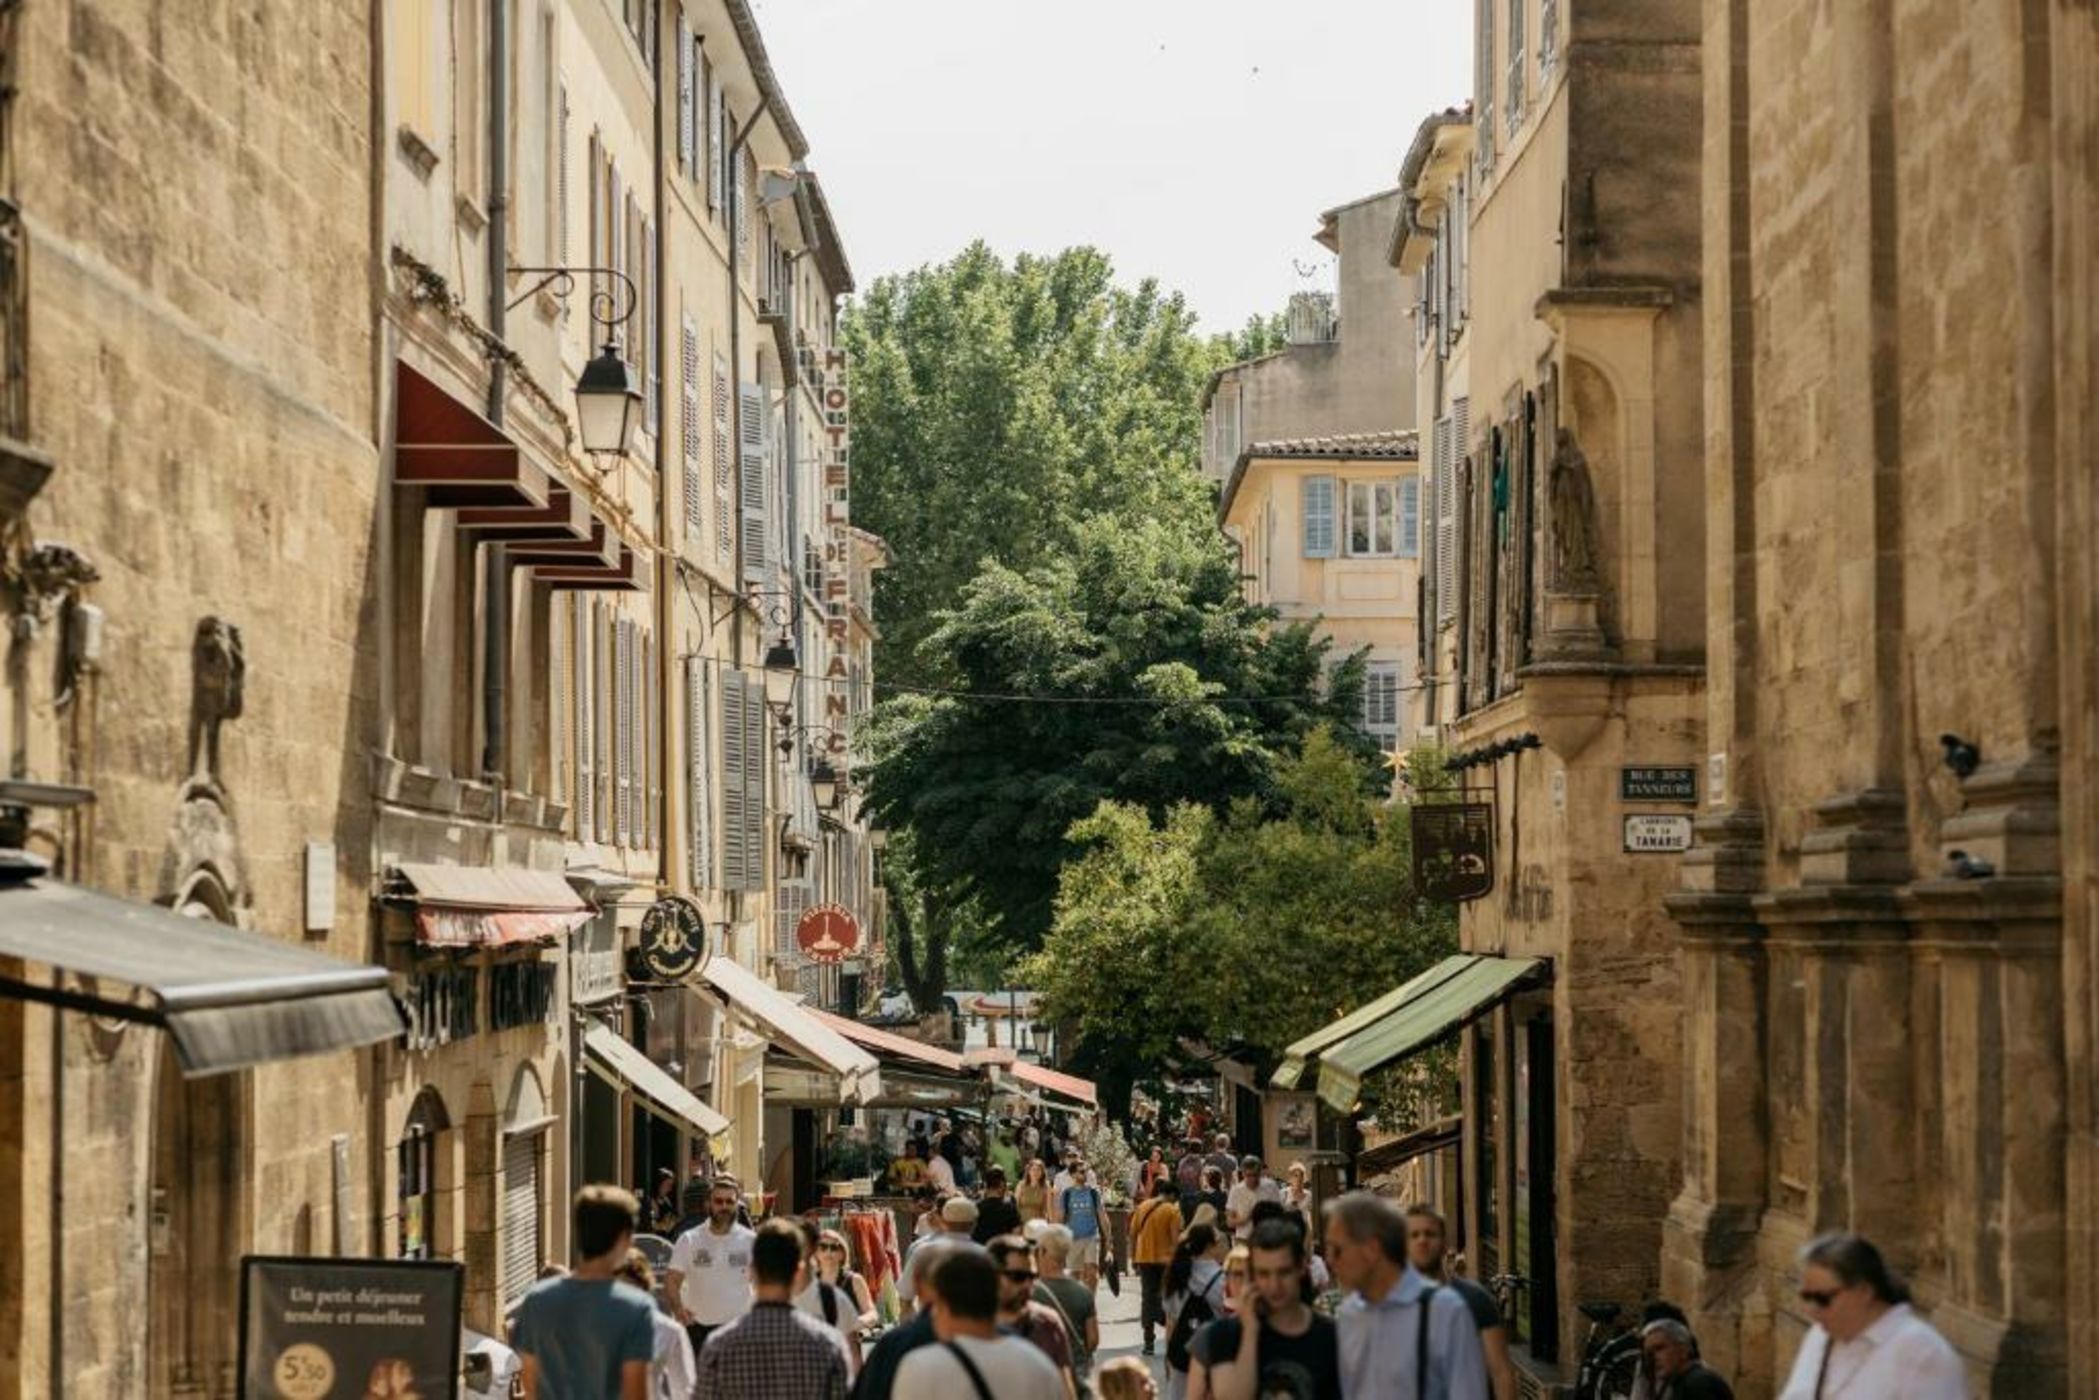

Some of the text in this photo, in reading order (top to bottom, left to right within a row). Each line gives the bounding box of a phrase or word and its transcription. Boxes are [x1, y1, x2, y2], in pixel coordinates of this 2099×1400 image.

[825, 349, 846, 524] HOTEL
[826, 543, 847, 562] DE
[1631, 770, 1654, 780] RUE
[1628, 783, 1691, 794] TANNEURS
[290, 1287, 422, 1308] Un petit déjeuner
[284, 1309, 425, 1325] tendre et moelleux
